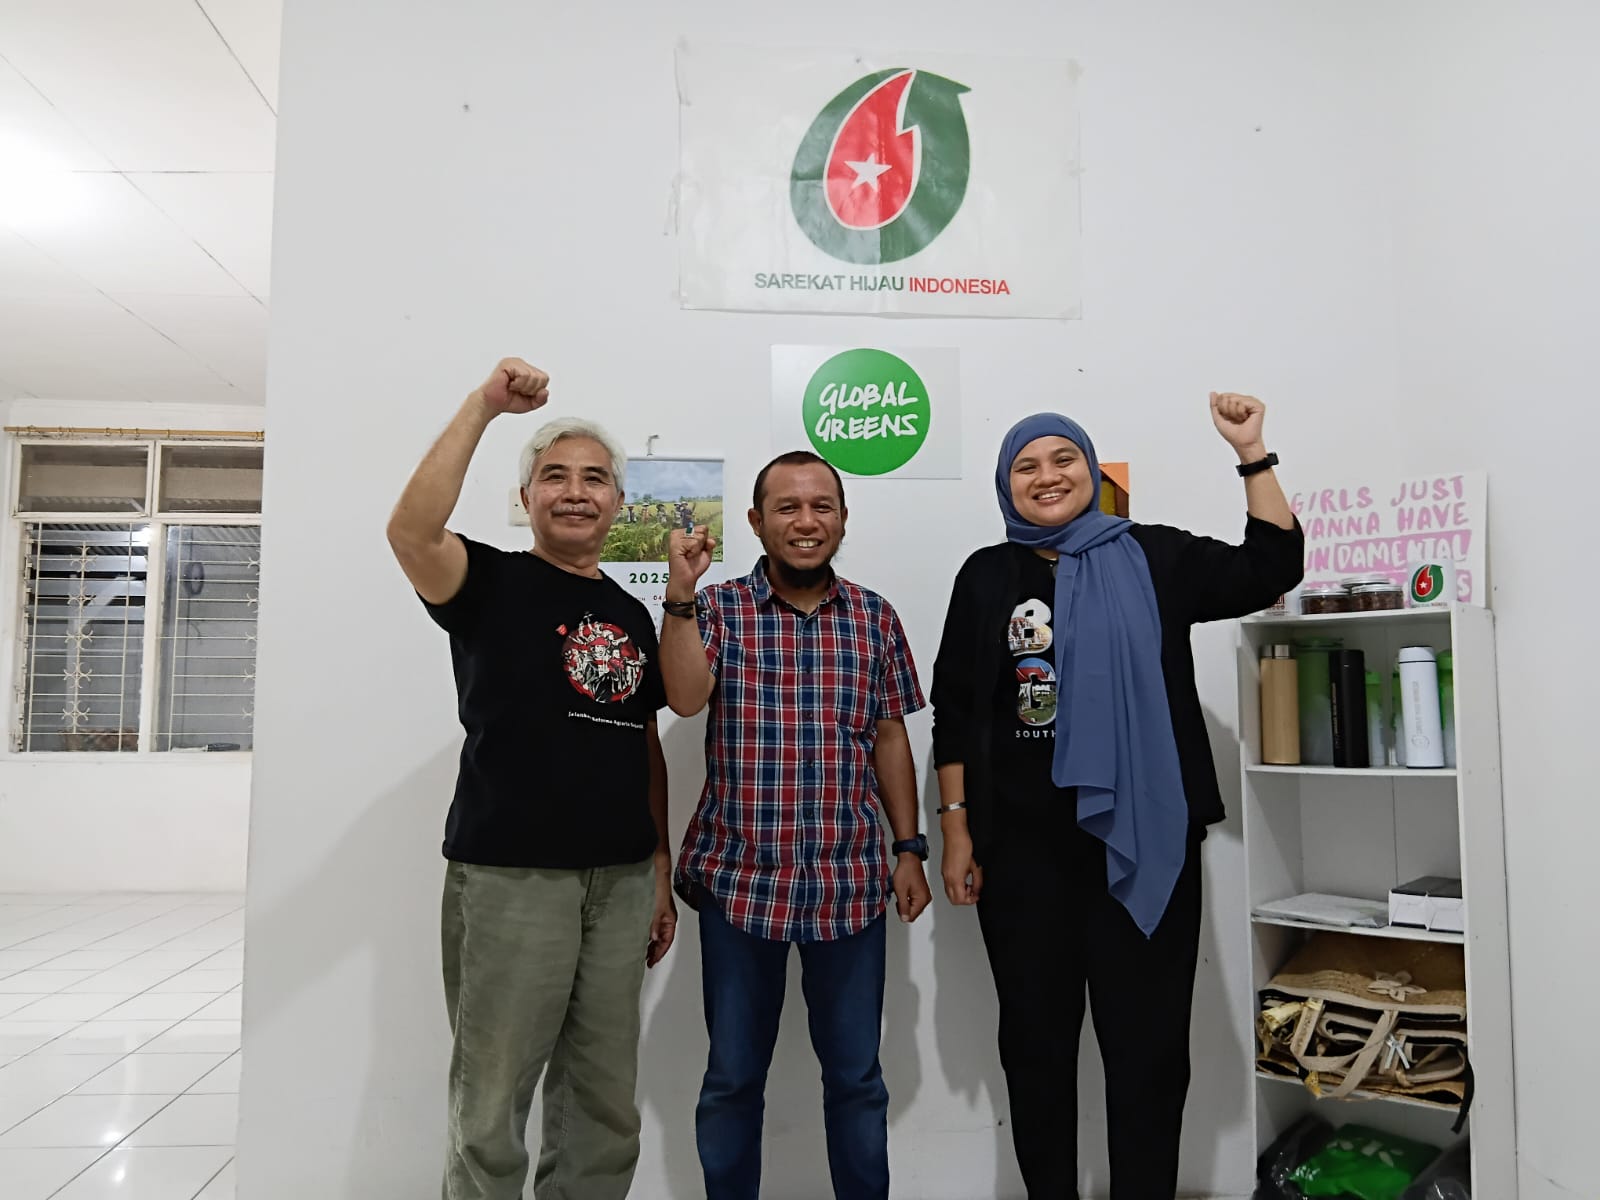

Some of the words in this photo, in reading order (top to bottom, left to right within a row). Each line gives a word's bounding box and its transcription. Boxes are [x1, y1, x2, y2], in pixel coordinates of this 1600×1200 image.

[754, 273, 845, 291] SAREKAT
[850, 275, 904, 291] HIJAU
[909, 277, 1011, 295] INDONESIA
[819, 381, 919, 415] GLOBAL
[815, 412, 918, 442] GREENS
[1290, 487, 1374, 515] GIRLS
[1390, 475, 1463, 507] JUST
[1397, 502, 1468, 533] HAVE
[629, 572, 669, 584] 2025
